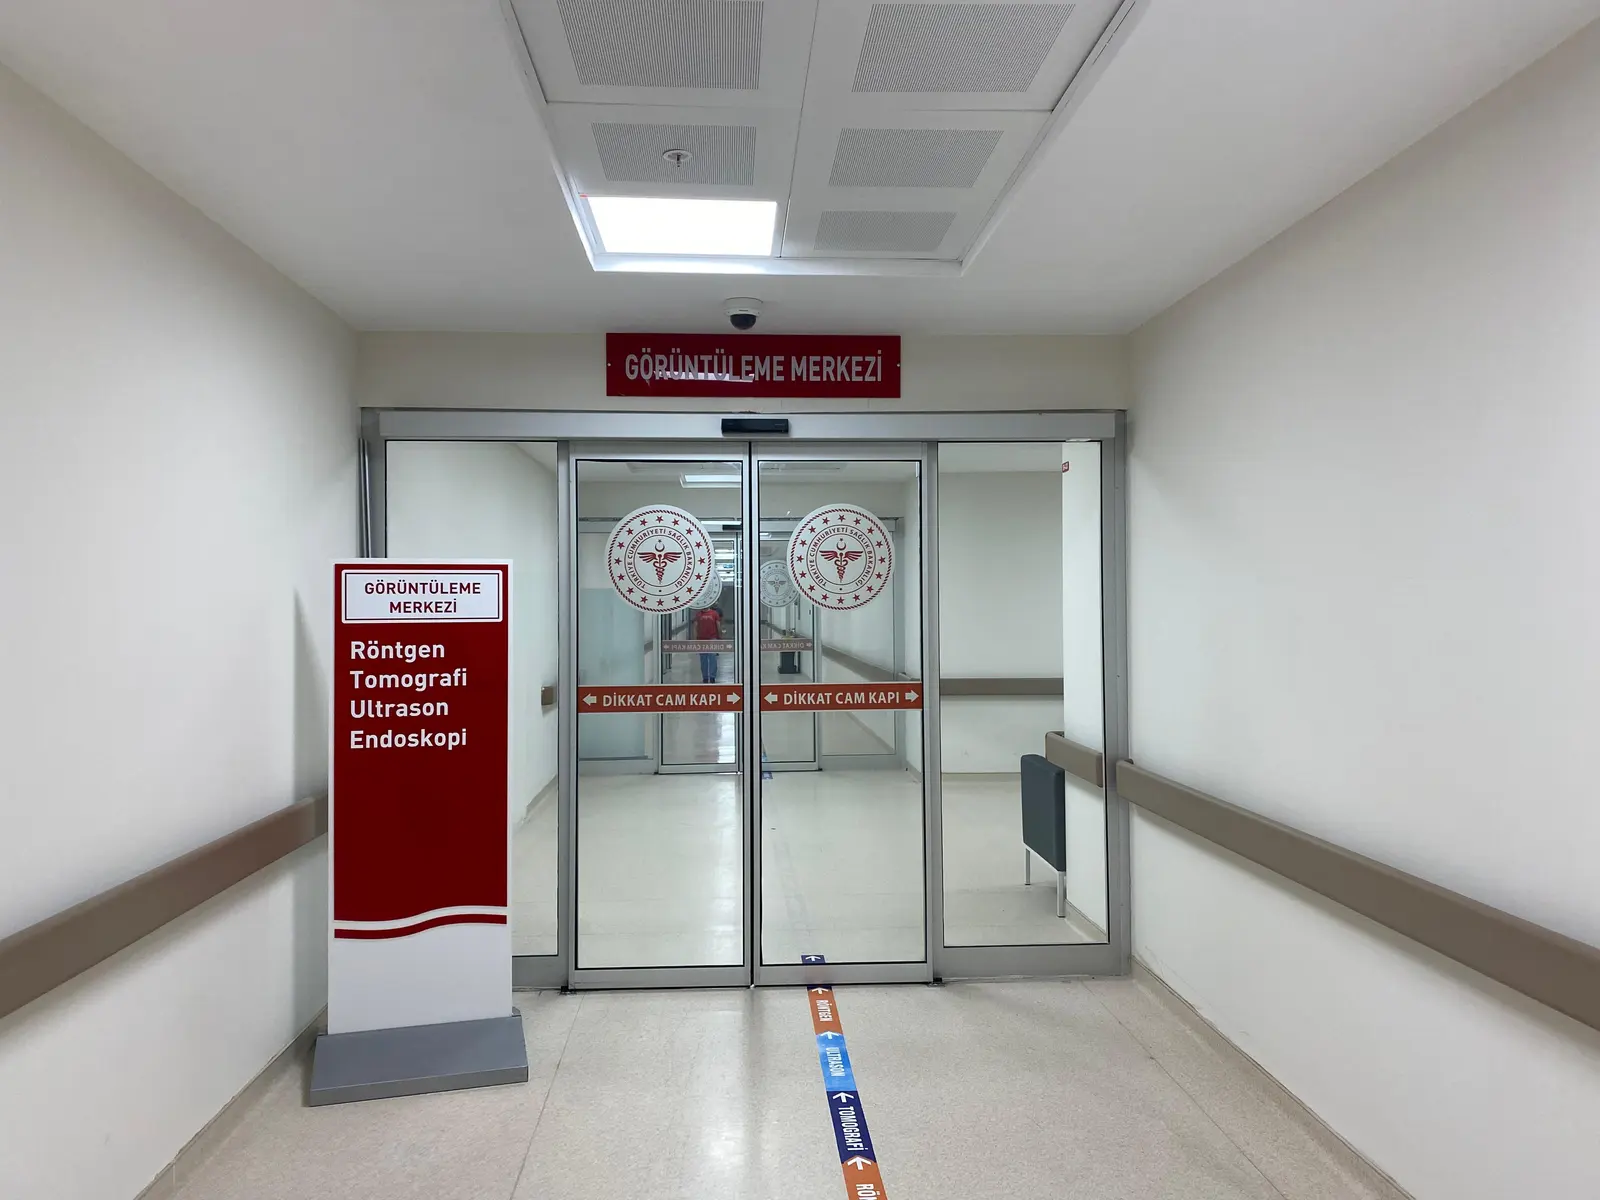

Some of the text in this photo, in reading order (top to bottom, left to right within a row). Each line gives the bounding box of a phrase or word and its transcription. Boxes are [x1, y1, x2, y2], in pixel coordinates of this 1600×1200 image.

[625, 348, 882, 382] GÖRÜNTÜLEME MERKEZİ
[628, 528, 667, 560] CUMHURİYETİ
[667, 530, 689, 550] SAĞLIK
[810, 526, 848, 557] CUMHURİYETİ
[849, 529, 871, 549] SAĞLIK
[627, 561, 646, 589] TÜRKİYE
[809, 559, 827, 587] TÜRKİYE
[364, 579, 481, 595] GÖRÜNTÜLEME
[389, 598, 457, 613] MERKEZİ
[350, 640, 445, 663] Röntgen
[349, 667, 467, 692] Tomografi
[350, 699, 449, 718] Ultrason
[602, 692, 721, 707] DİKKAT CAM KAPI
[783, 690, 899, 705] DİKKAT CAM KAPI
[350, 728, 467, 750] Endoskopi
[825, 1046, 846, 1077] ULTRASON
[838, 1105, 868, 1151] TOMOGRAFİ
